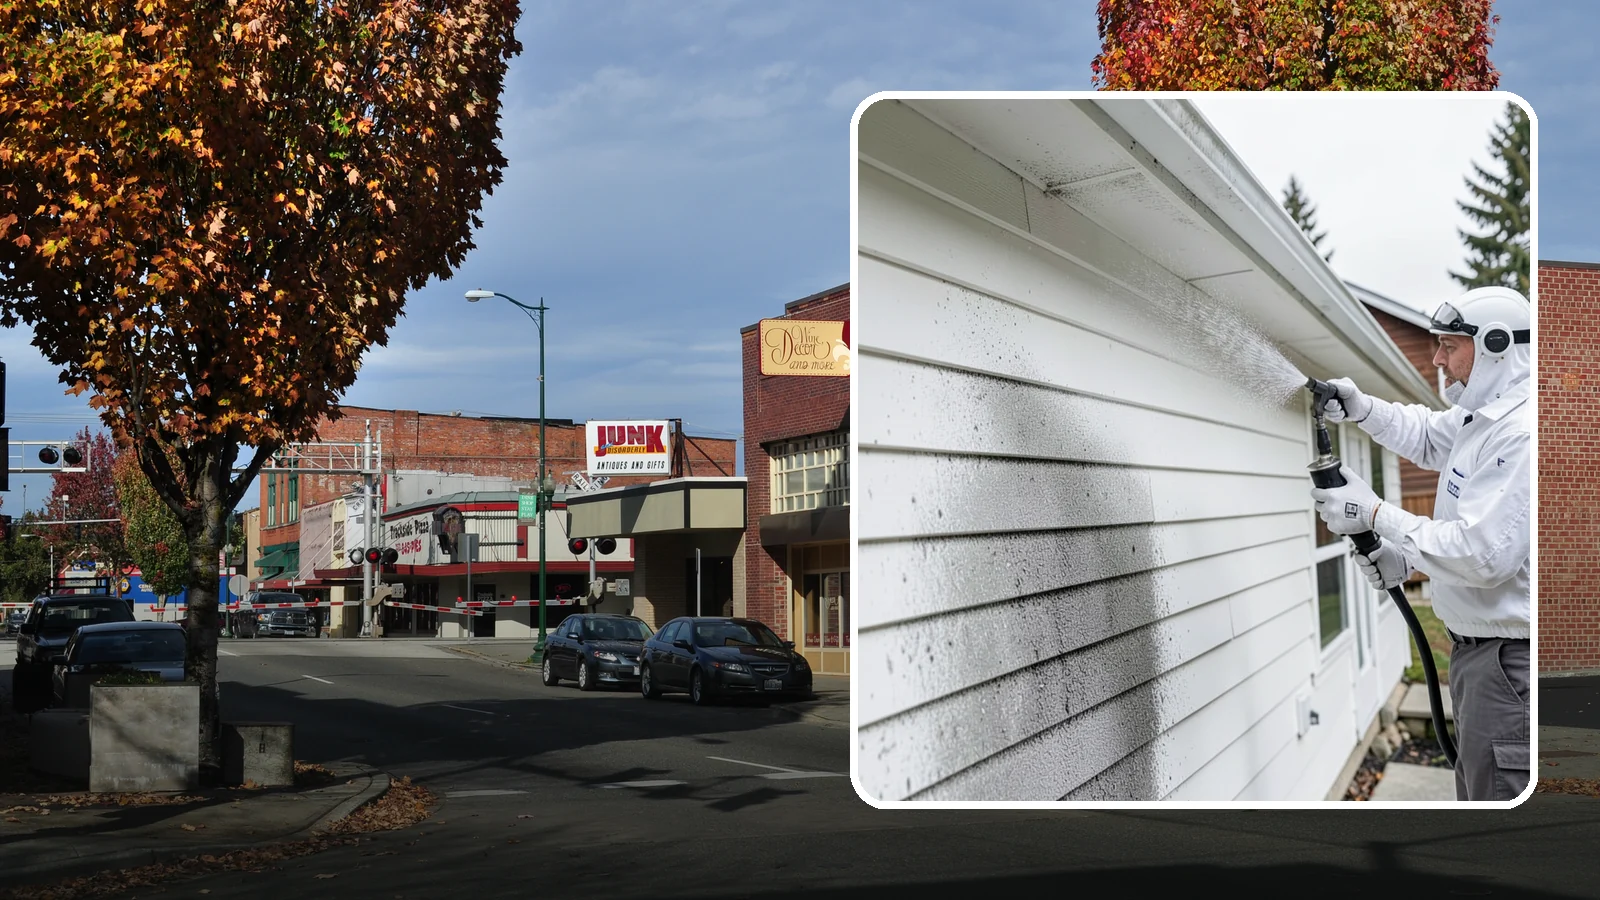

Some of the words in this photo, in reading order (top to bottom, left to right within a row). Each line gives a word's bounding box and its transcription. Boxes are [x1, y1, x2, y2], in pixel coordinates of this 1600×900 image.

[596, 425, 665, 457] JUNK
[607, 446, 645, 454] DISORDERLY
[597, 461, 628, 470] ANTIQUES
[630, 461, 644, 470] AND
[647, 460, 666, 469] GIFTS
[390, 521, 413, 540] Trackside
[414, 519, 429, 535] Pizza
